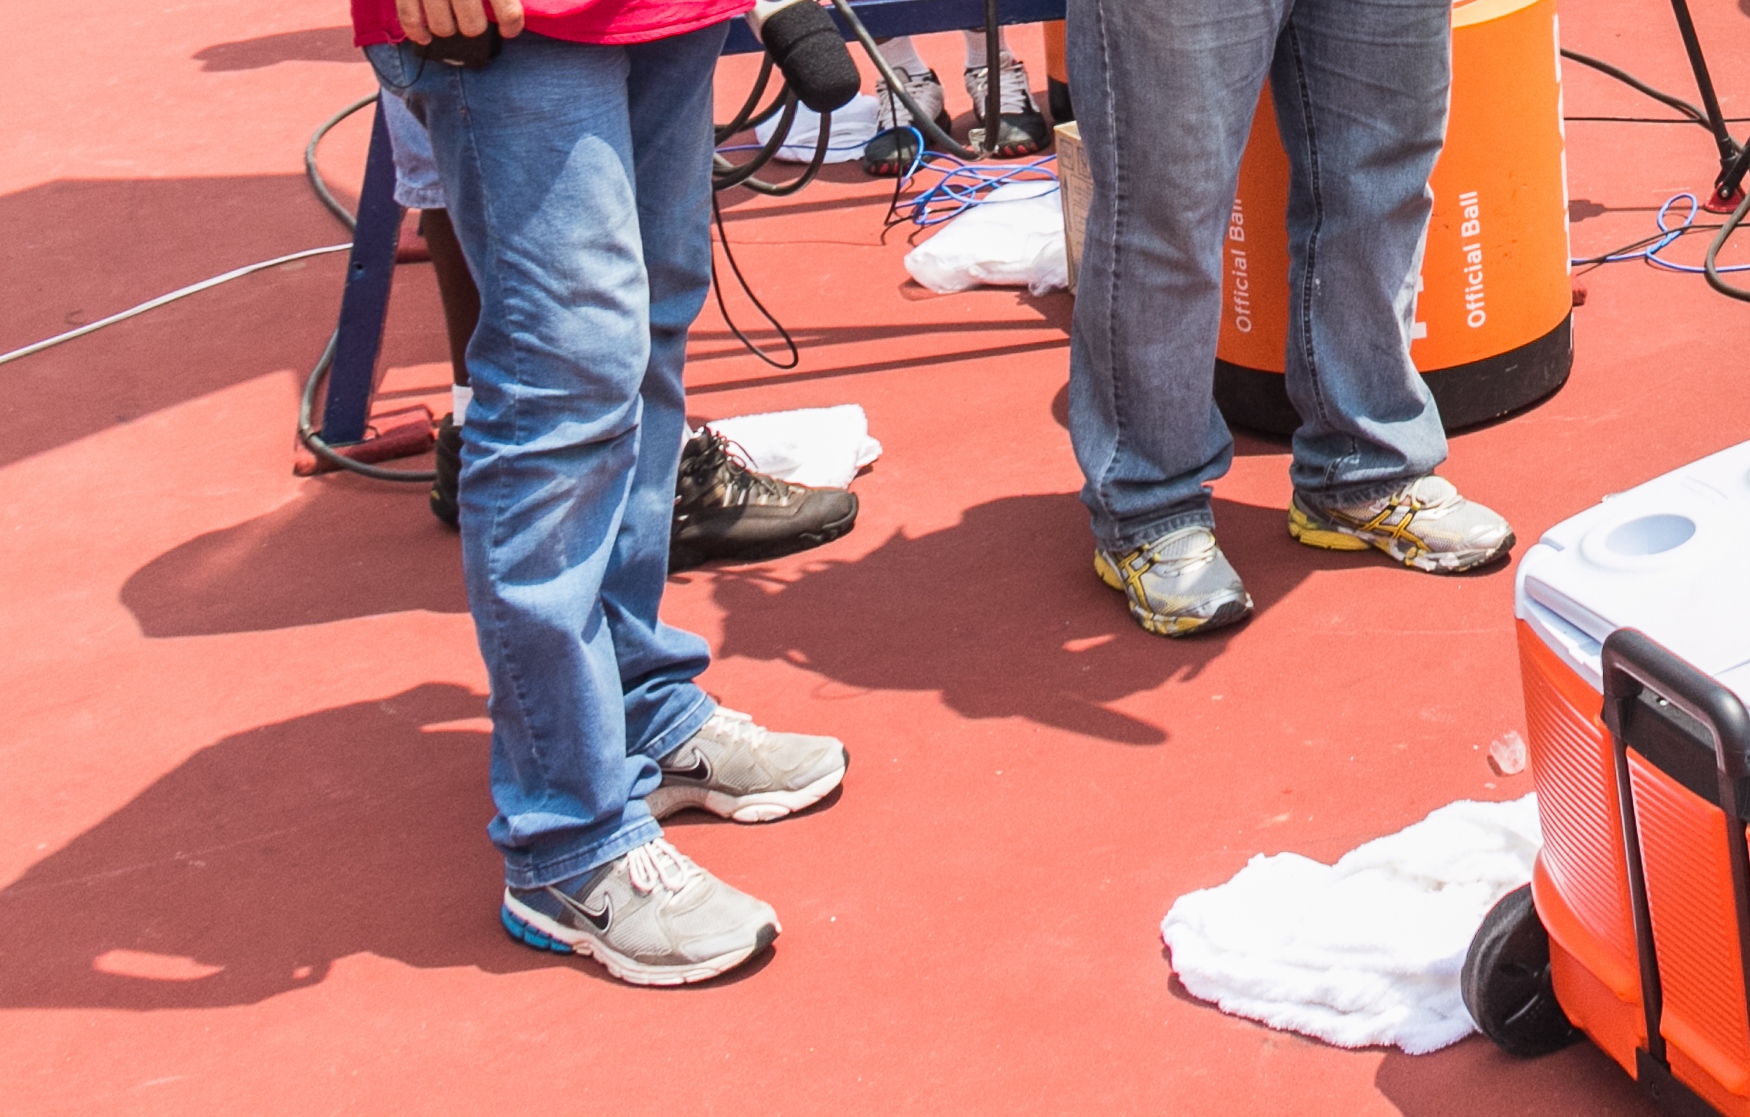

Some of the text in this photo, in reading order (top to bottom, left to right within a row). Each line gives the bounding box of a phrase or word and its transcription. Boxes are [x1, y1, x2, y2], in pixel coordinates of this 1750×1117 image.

[1234, 249, 1252, 334] Official
[1459, 190, 1487, 329] Official Ball
